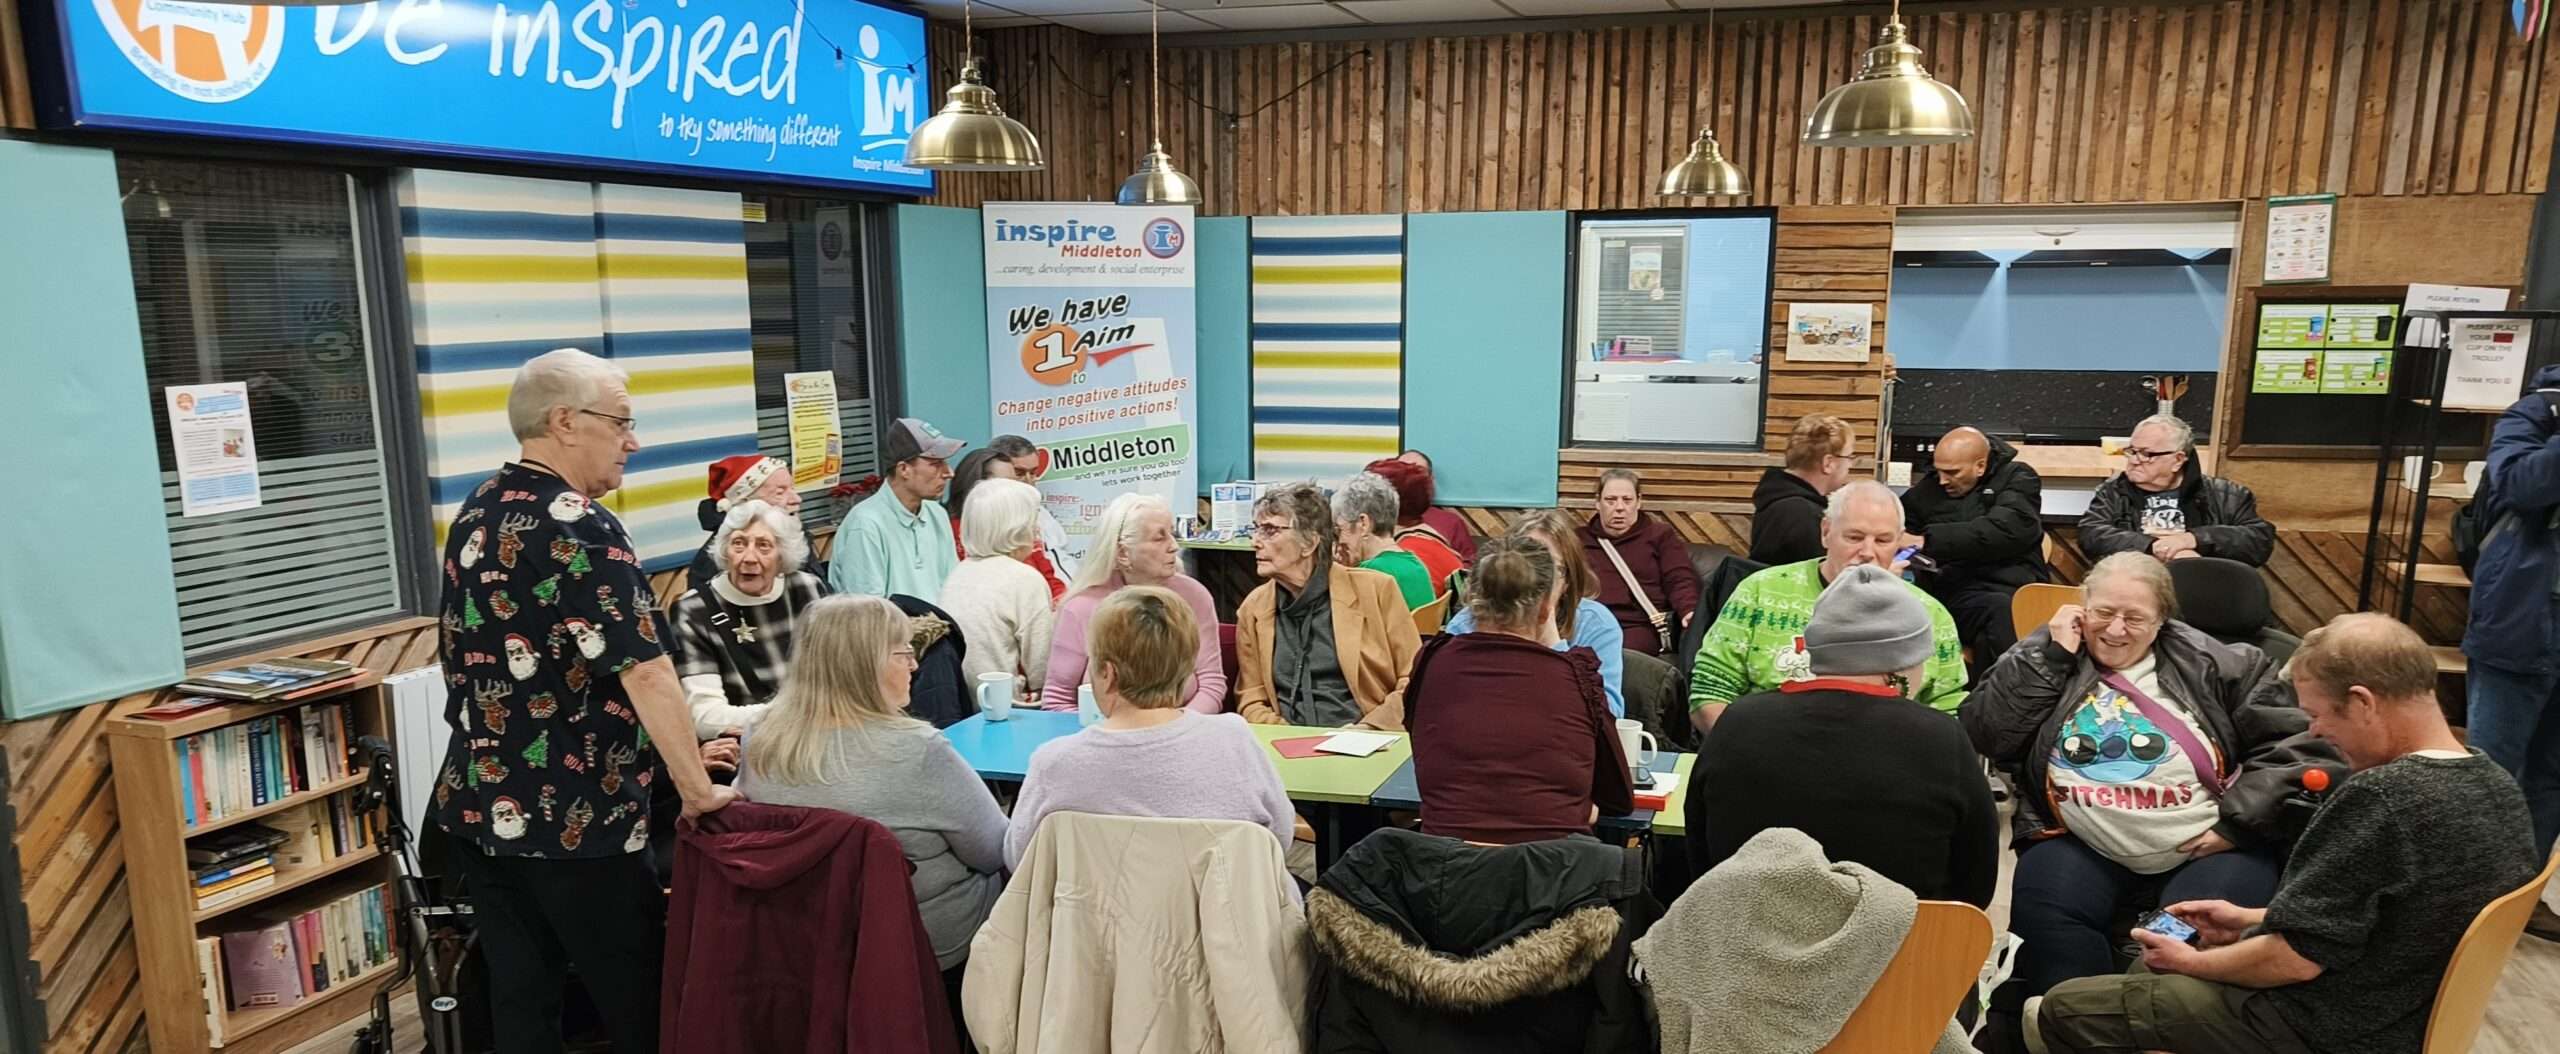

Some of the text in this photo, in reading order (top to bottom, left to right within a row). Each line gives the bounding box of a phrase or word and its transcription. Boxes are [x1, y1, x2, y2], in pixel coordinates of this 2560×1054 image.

[659, 113, 843, 162] to try something different
[853, 155, 882, 172] Inspire
[995, 219, 1117, 248] inspire
[1061, 244, 1142, 258] Middleton
[1038, 263, 1097, 277] development
[1100, 264, 1107, 275] &
[1110, 263, 1137, 275] social
[1140, 264, 1185, 277] enterprise
[1009, 294, 1127, 332] We have
[1034, 324, 1135, 373] 1 Aim
[1073, 372, 1086, 384] to
[998, 377, 1187, 415] Change negative attitudes
[1026, 397, 1178, 432] into positive actions!
[1053, 436, 1175, 470] Middleton
[1075, 472, 1092, 481] and
[1119, 466, 1138, 474] sure
[1140, 463, 1157, 472] you
[1158, 460, 1169, 468] do
[1102, 469, 1181, 487] lets work together
